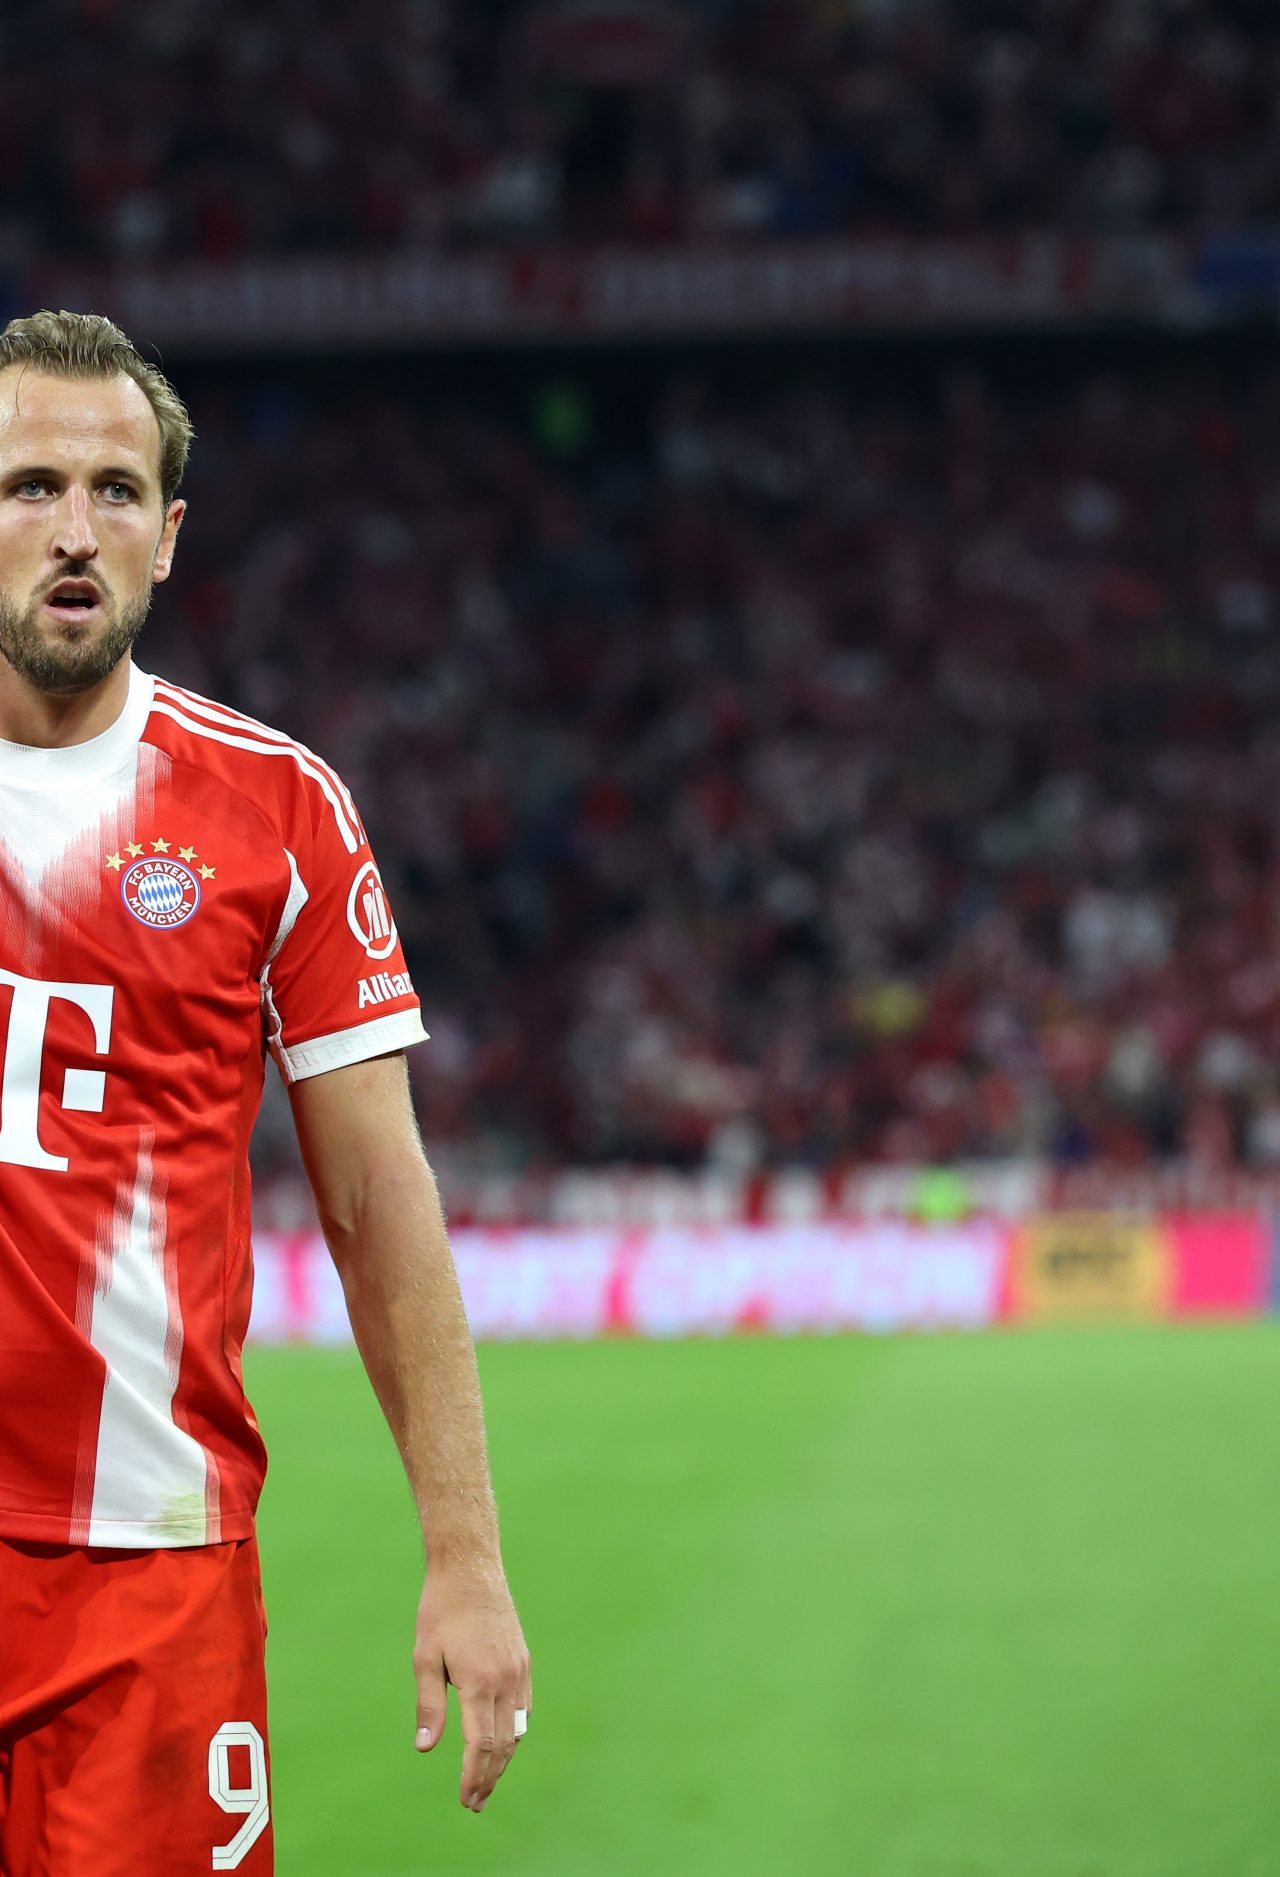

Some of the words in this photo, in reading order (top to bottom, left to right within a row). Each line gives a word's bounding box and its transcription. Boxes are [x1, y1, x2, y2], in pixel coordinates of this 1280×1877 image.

[129, 871, 143, 886] FC
[144, 863, 194, 890] BAYERN
[129, 897, 193, 925] MÜNCHEN
[208, 1721, 269, 1870] 9
